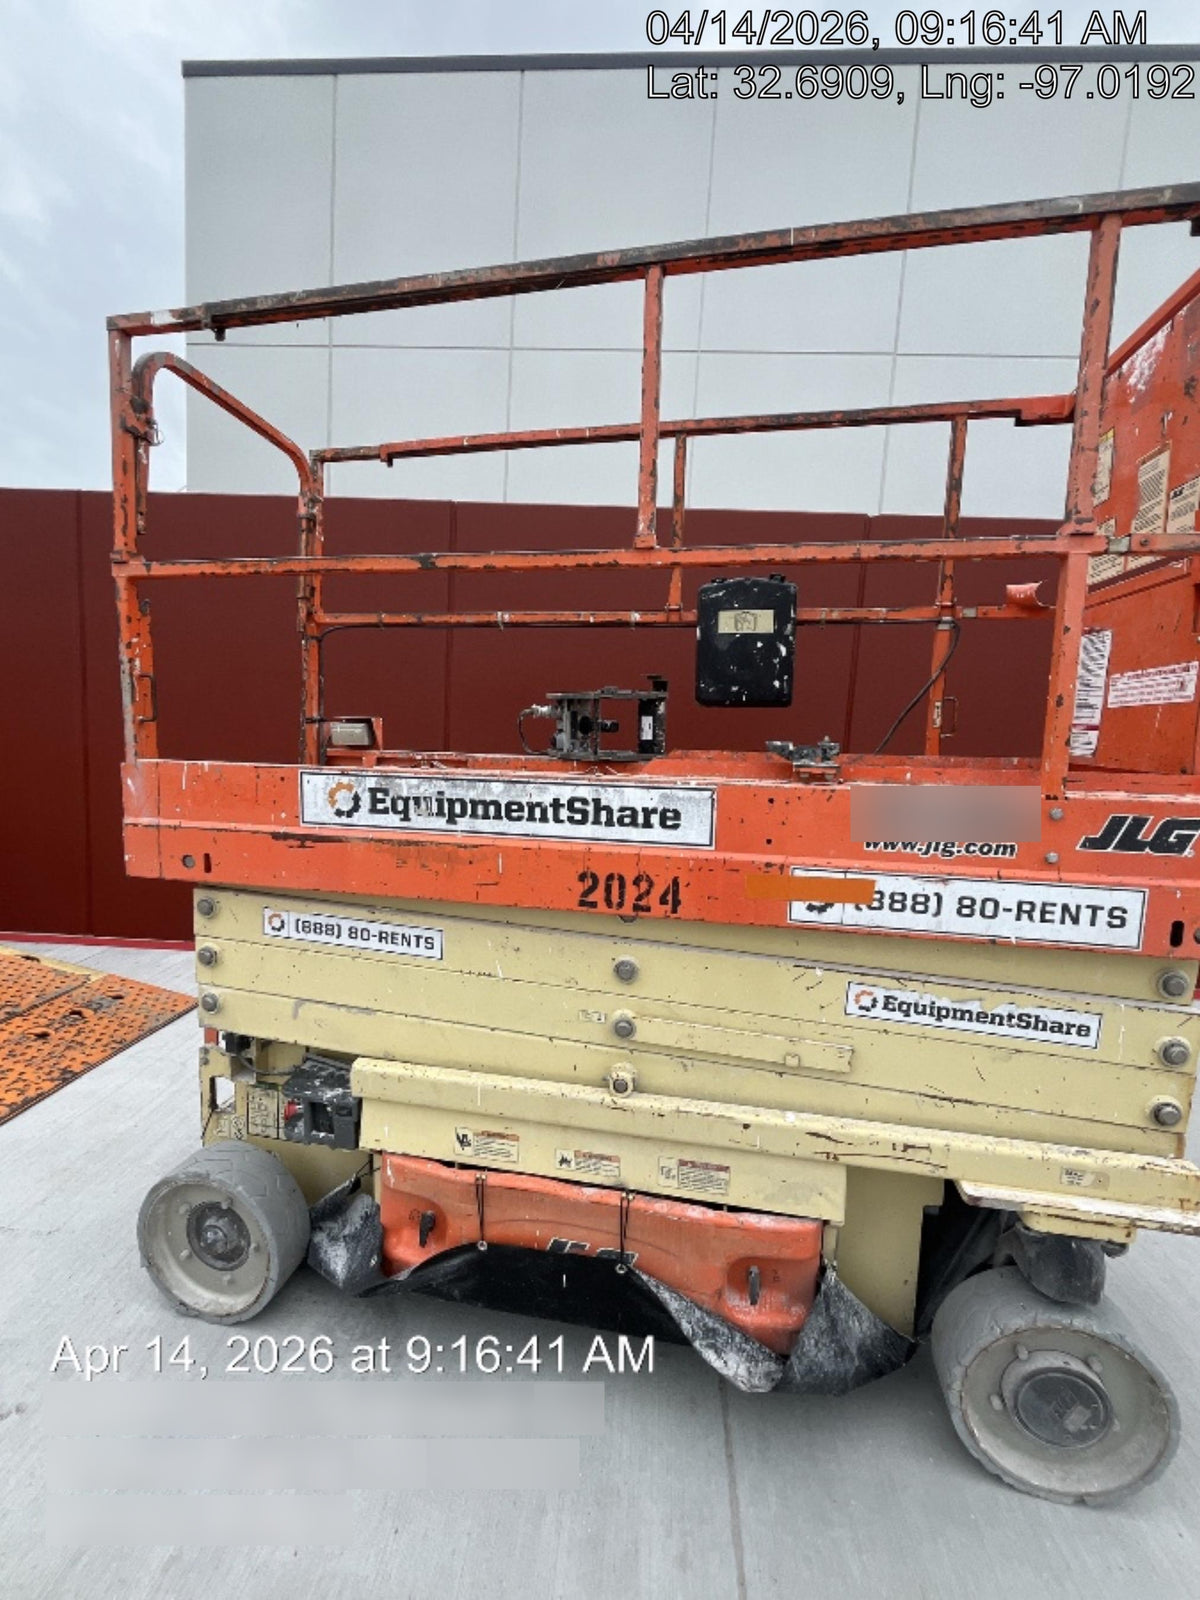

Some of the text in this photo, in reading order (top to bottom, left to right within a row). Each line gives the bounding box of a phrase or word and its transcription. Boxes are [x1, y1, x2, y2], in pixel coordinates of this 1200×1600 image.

[367, 786, 682, 831] EquipmentShare
[1075, 813, 1200, 858] JLG
[576, 871, 681, 914] 2024
[854, 890, 1129, 930] 888) 80-RENTS
[294, 919, 436, 951] (888) 80-RENTS
[881, 994, 1091, 1039] EquipmentShare
